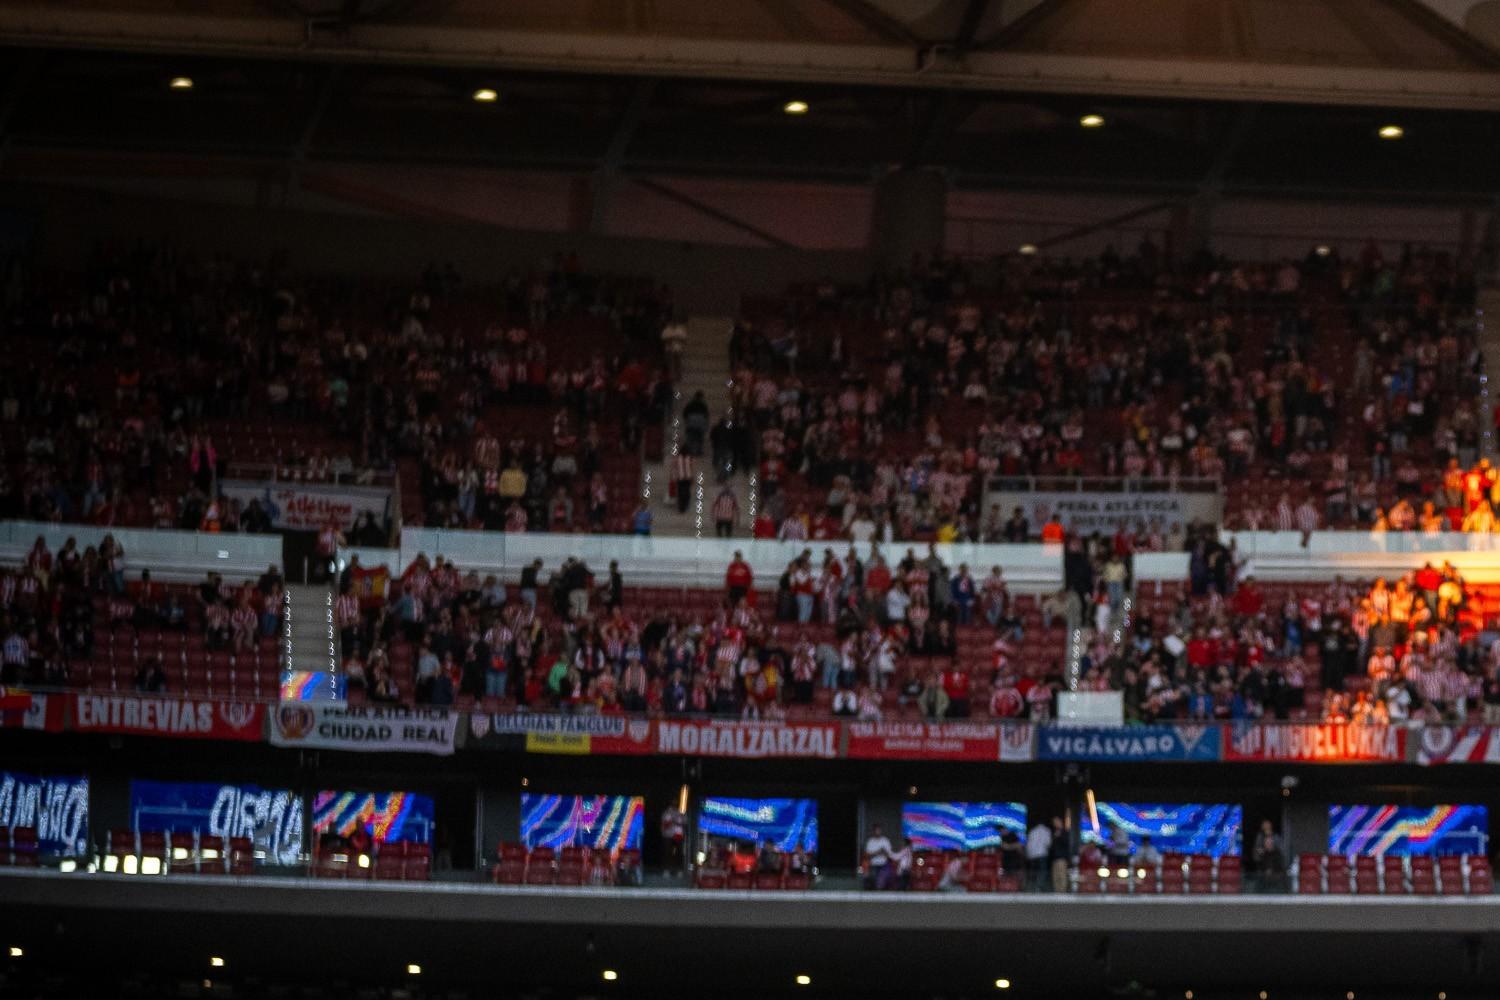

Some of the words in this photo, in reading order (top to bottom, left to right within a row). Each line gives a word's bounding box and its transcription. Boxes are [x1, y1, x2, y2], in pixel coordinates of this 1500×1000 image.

[77, 693, 214, 732] ENTREVIAS
[319, 724, 392, 742] CIUDAD
[402, 725, 449, 744] REAL
[659, 720, 836, 758] MORALZARZAL
[1047, 734, 1174, 755] VICÁLVARO
